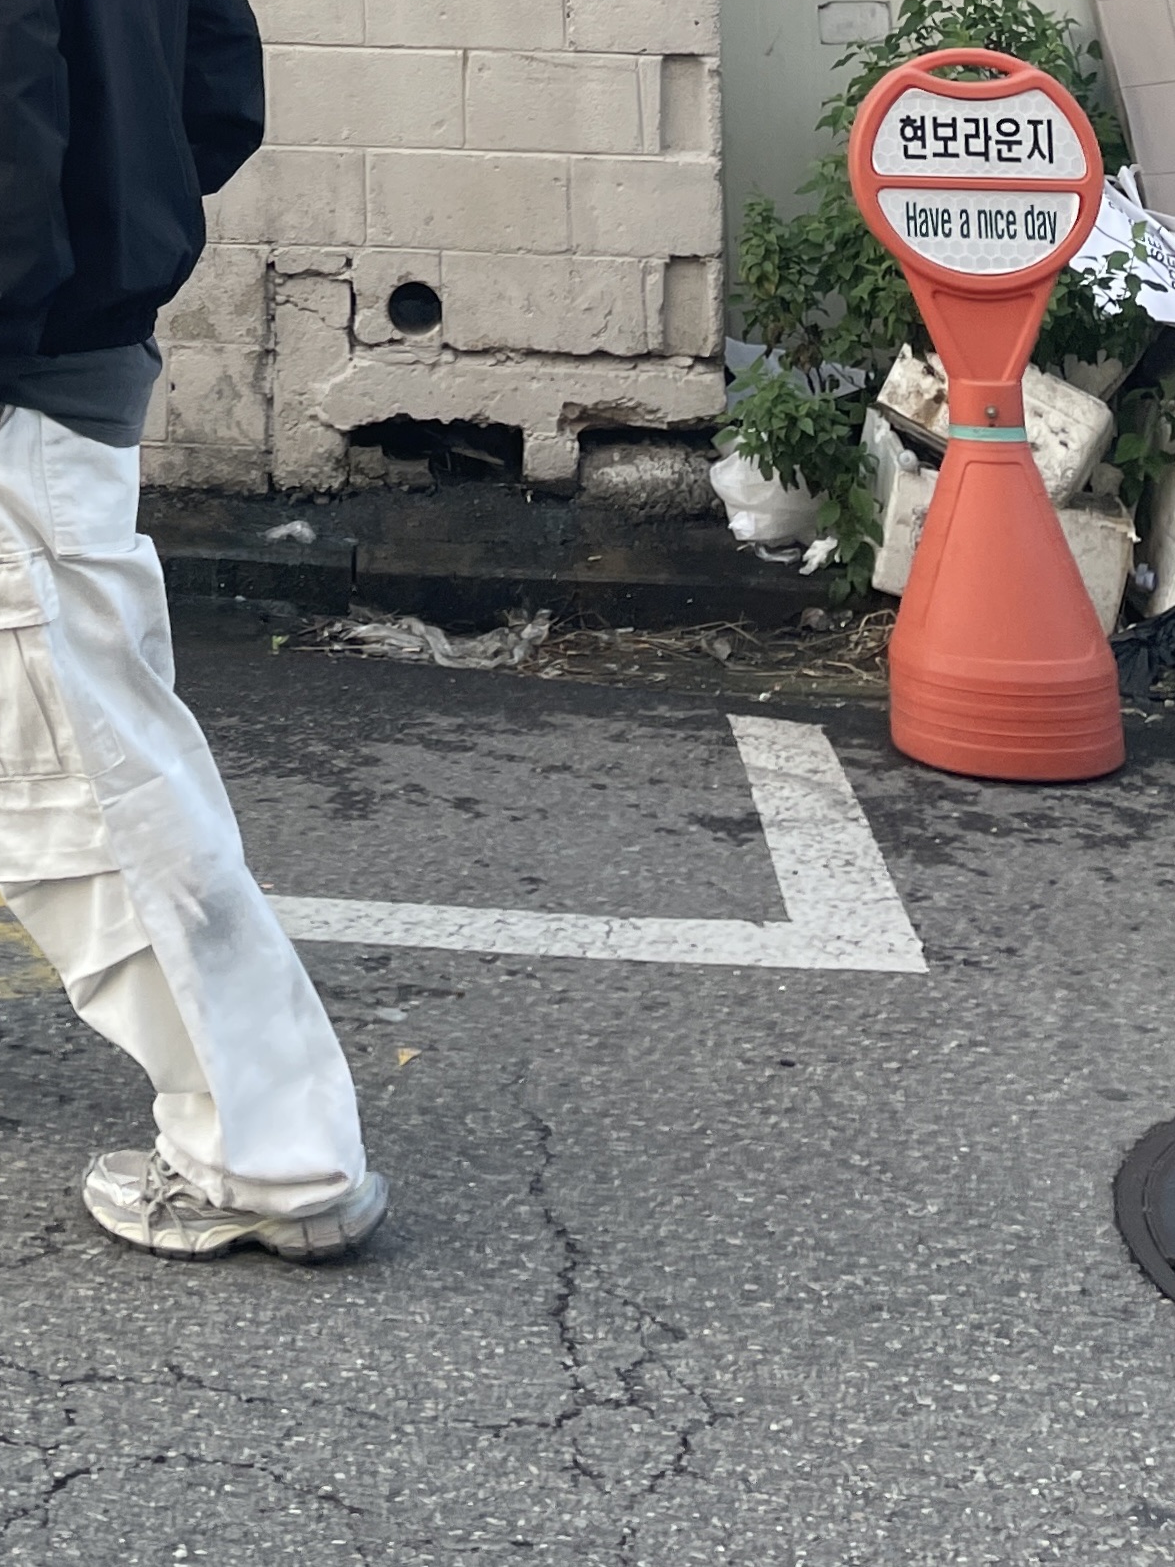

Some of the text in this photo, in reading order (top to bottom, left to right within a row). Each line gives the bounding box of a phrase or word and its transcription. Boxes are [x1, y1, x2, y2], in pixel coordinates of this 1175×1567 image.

[899, 114, 1055, 164] 현보라운지
[905, 201, 1058, 244] Have a nice day
